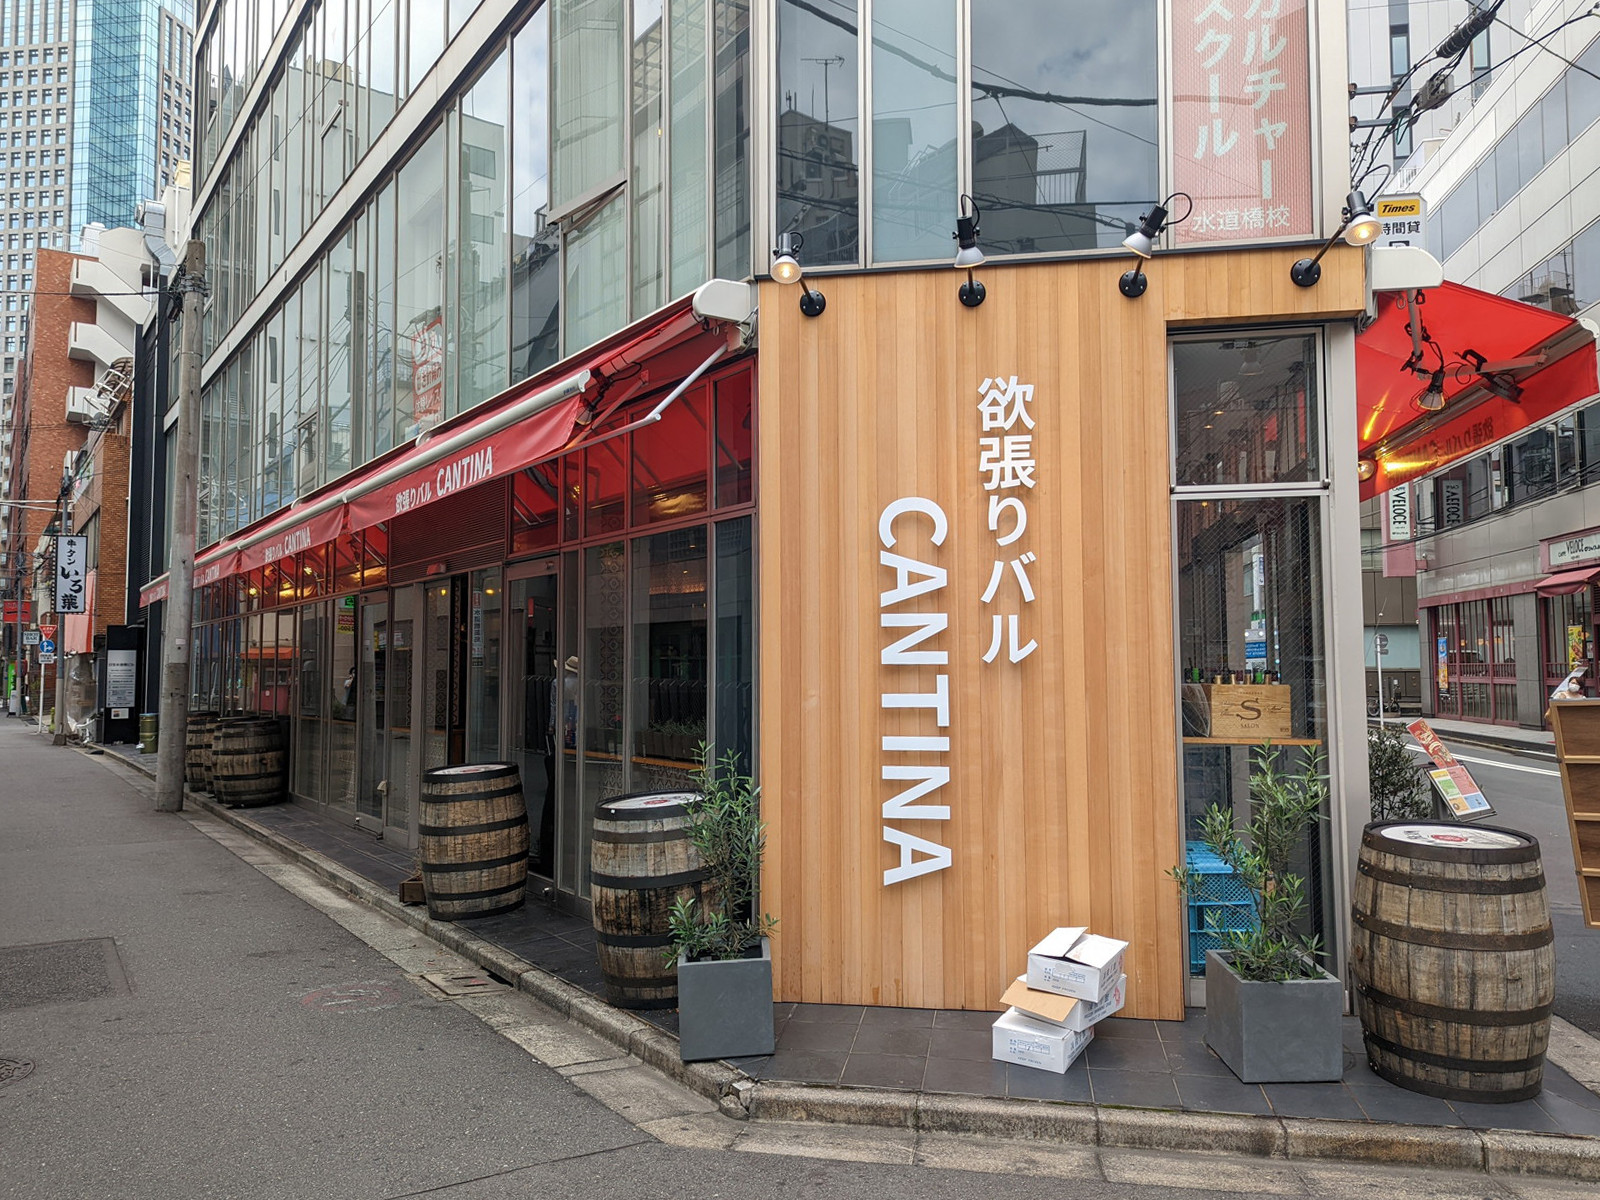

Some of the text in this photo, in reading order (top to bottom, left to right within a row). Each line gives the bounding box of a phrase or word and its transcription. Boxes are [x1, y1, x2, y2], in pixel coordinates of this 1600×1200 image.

[1192, 205, 1290, 233] 水道橋校
[1382, 204, 1416, 213] Times
[396, 446, 493, 515] 欲張りバル CANTINA
[976, 375, 1038, 664] 欲張りバル
[1392, 491, 1407, 525] VELOCE
[66, 539, 77, 566] 牛タン
[284, 526, 312, 555] CANTINA
[60, 566, 83, 611] いろ葉
[878, 497, 952, 887] CANTINA
[1235, 697, 1262, 721] S
